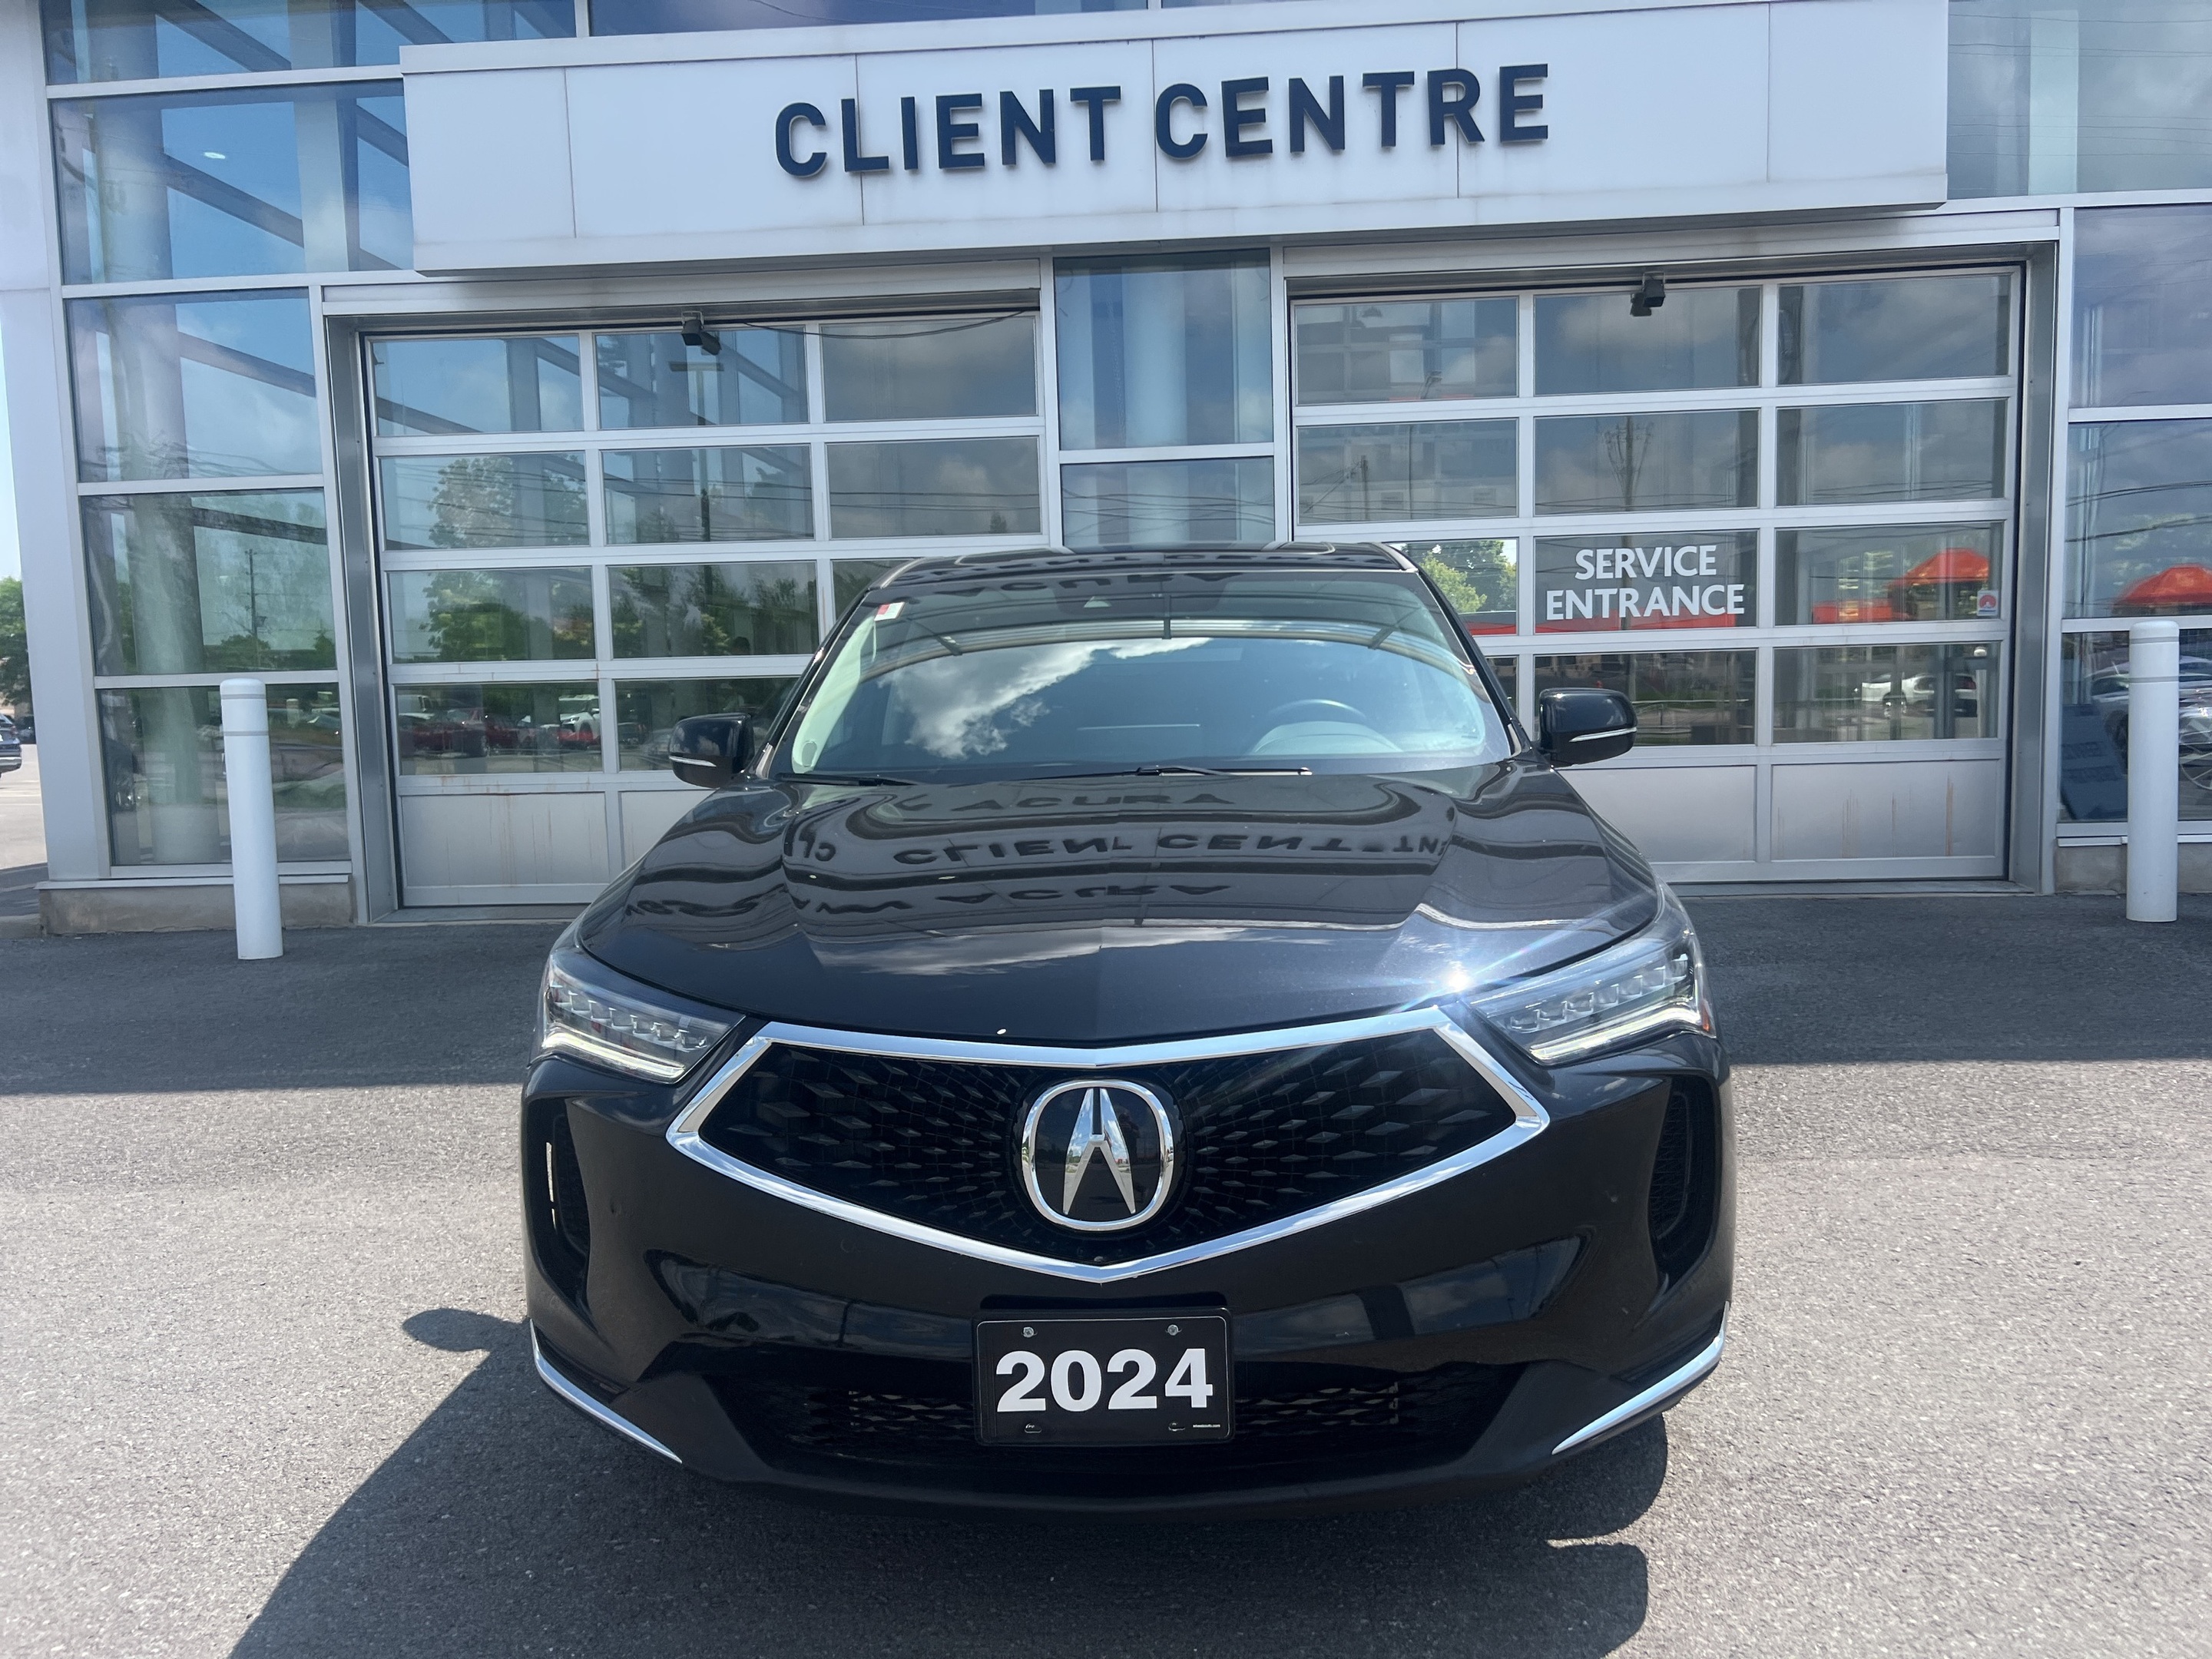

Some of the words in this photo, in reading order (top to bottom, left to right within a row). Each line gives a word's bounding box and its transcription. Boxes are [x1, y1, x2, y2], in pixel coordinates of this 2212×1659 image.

[775, 85, 1121, 177] CLIENT
[1154, 63, 1548, 160] CENTRE
[1575, 545, 1717, 581] SERVICE
[1546, 584, 1745, 621] ENTRANCE
[996, 1348, 1213, 1412] 2024
